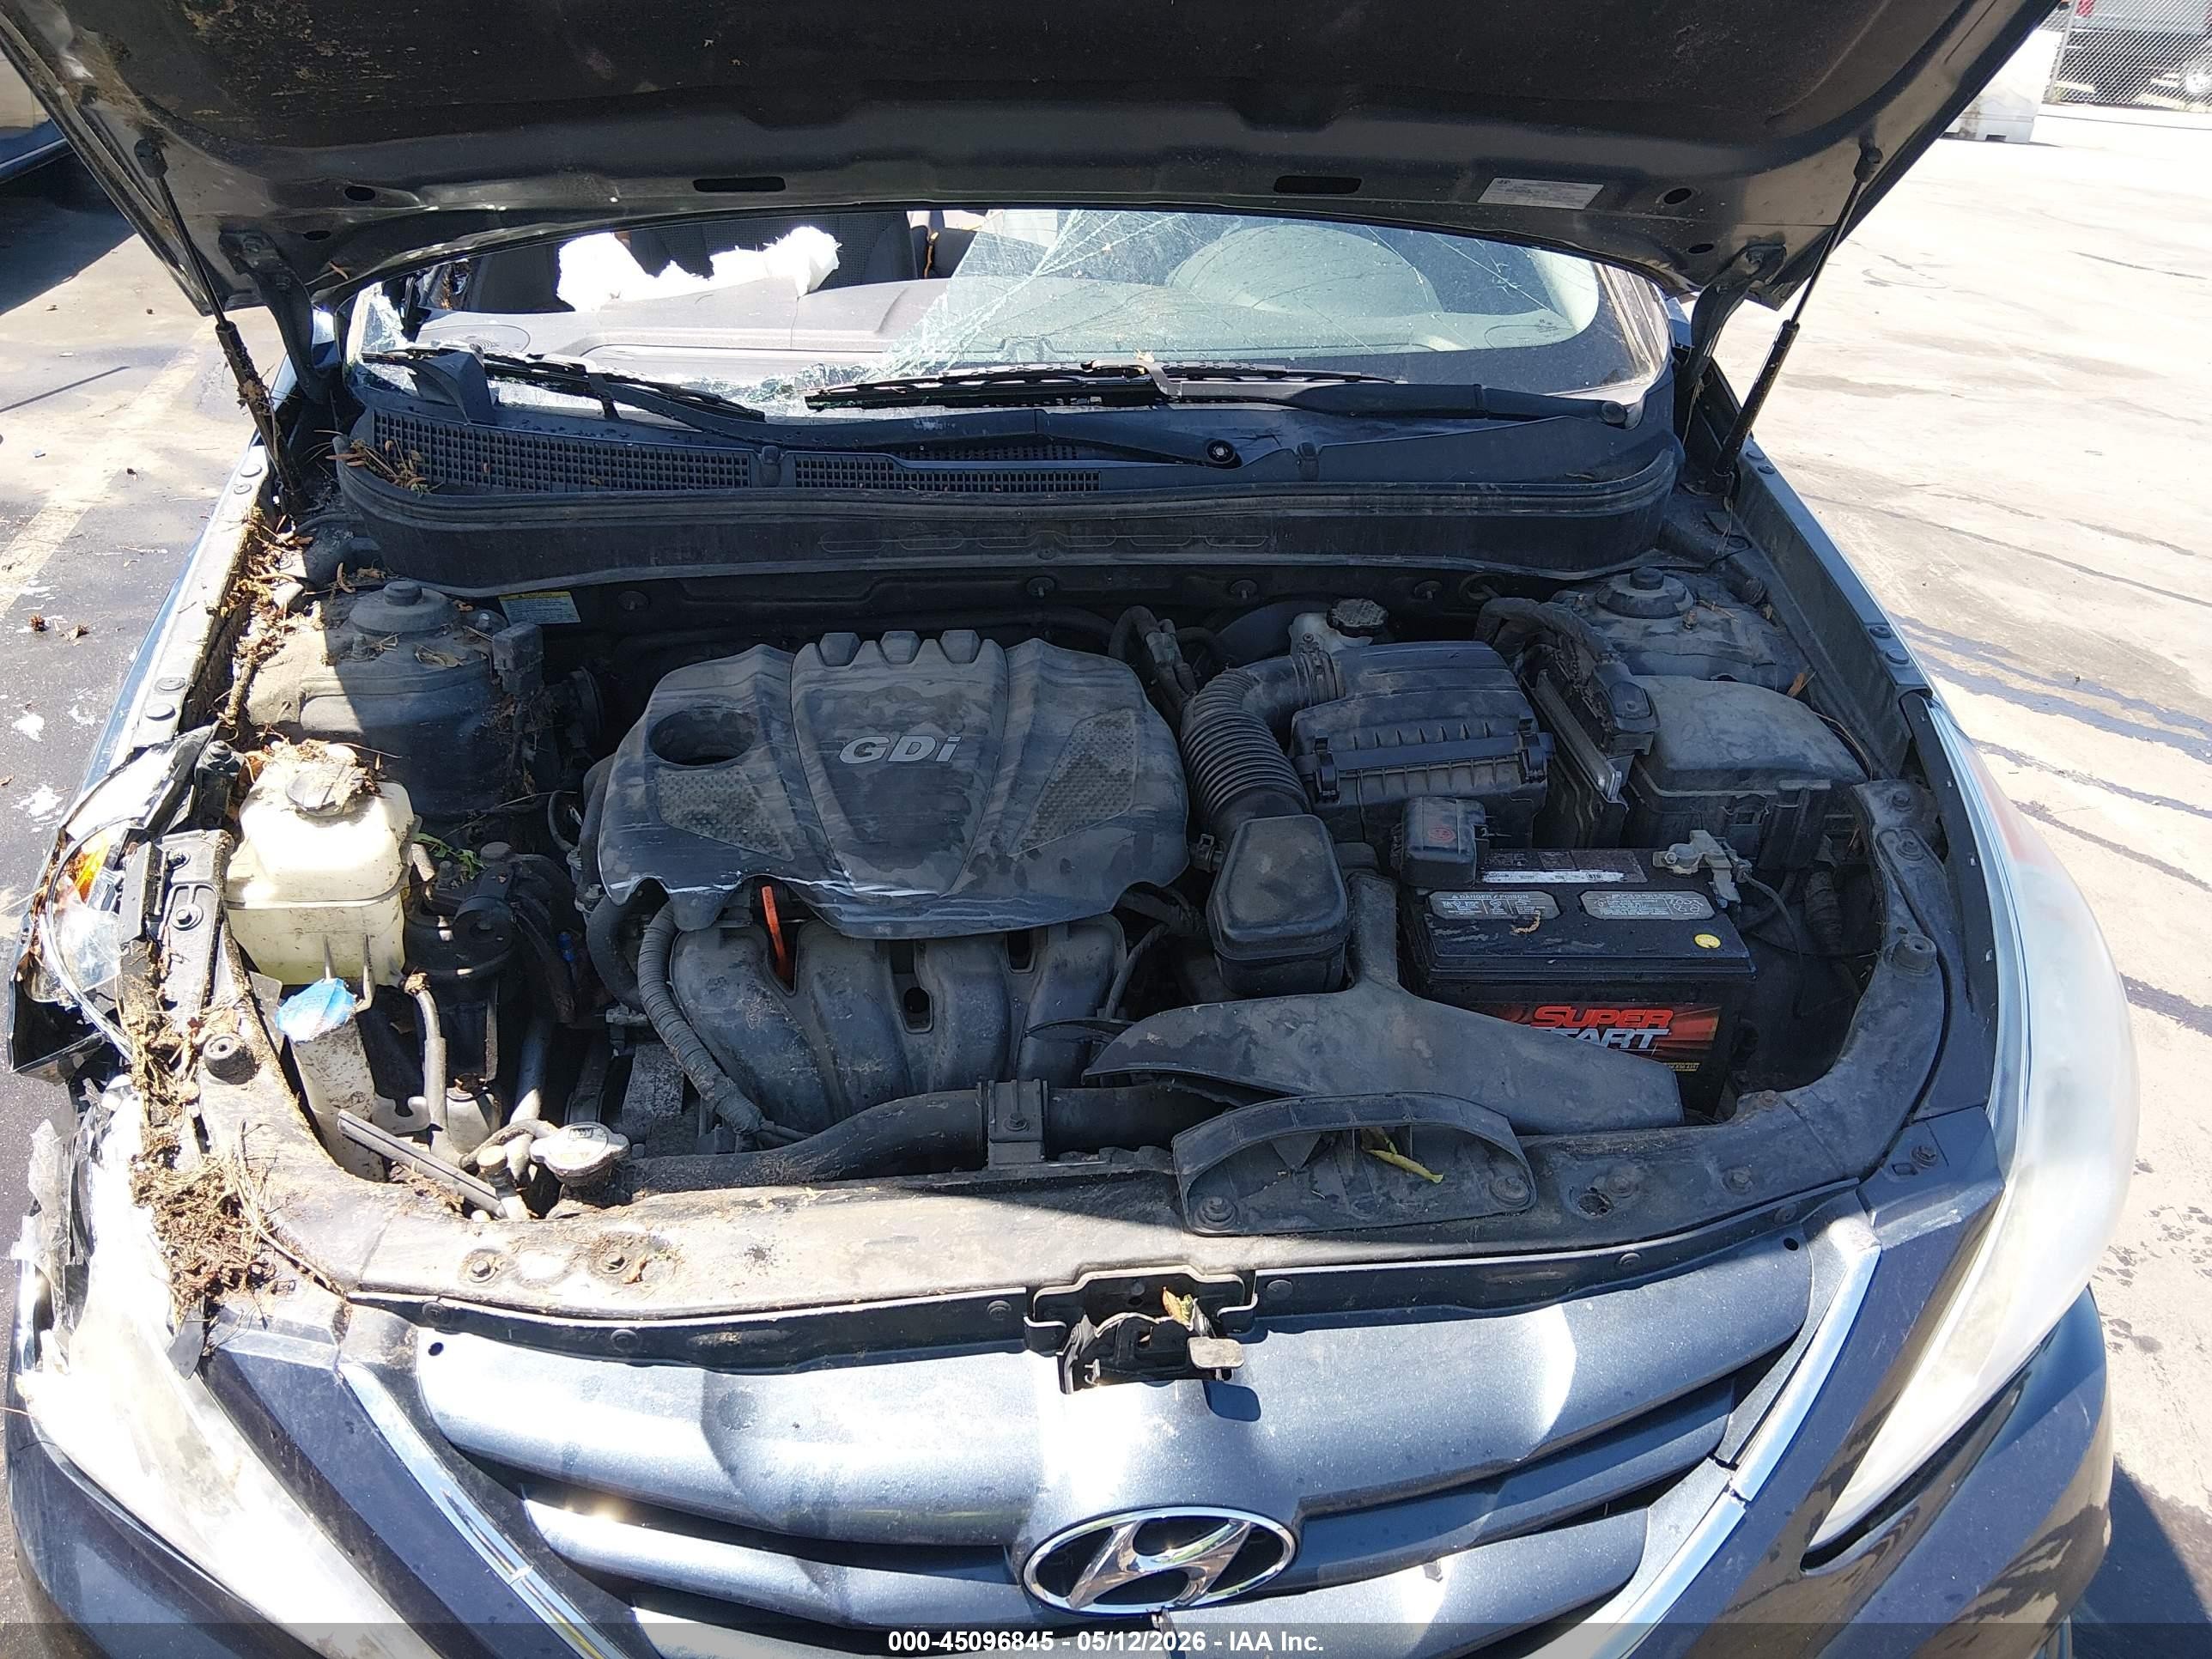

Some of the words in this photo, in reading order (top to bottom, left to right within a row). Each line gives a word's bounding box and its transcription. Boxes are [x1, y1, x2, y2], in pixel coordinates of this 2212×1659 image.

[839, 736, 962, 764] GDi
[1530, 1006, 1674, 1029] SUPER
[1534, 1028, 1671, 1049] ART
